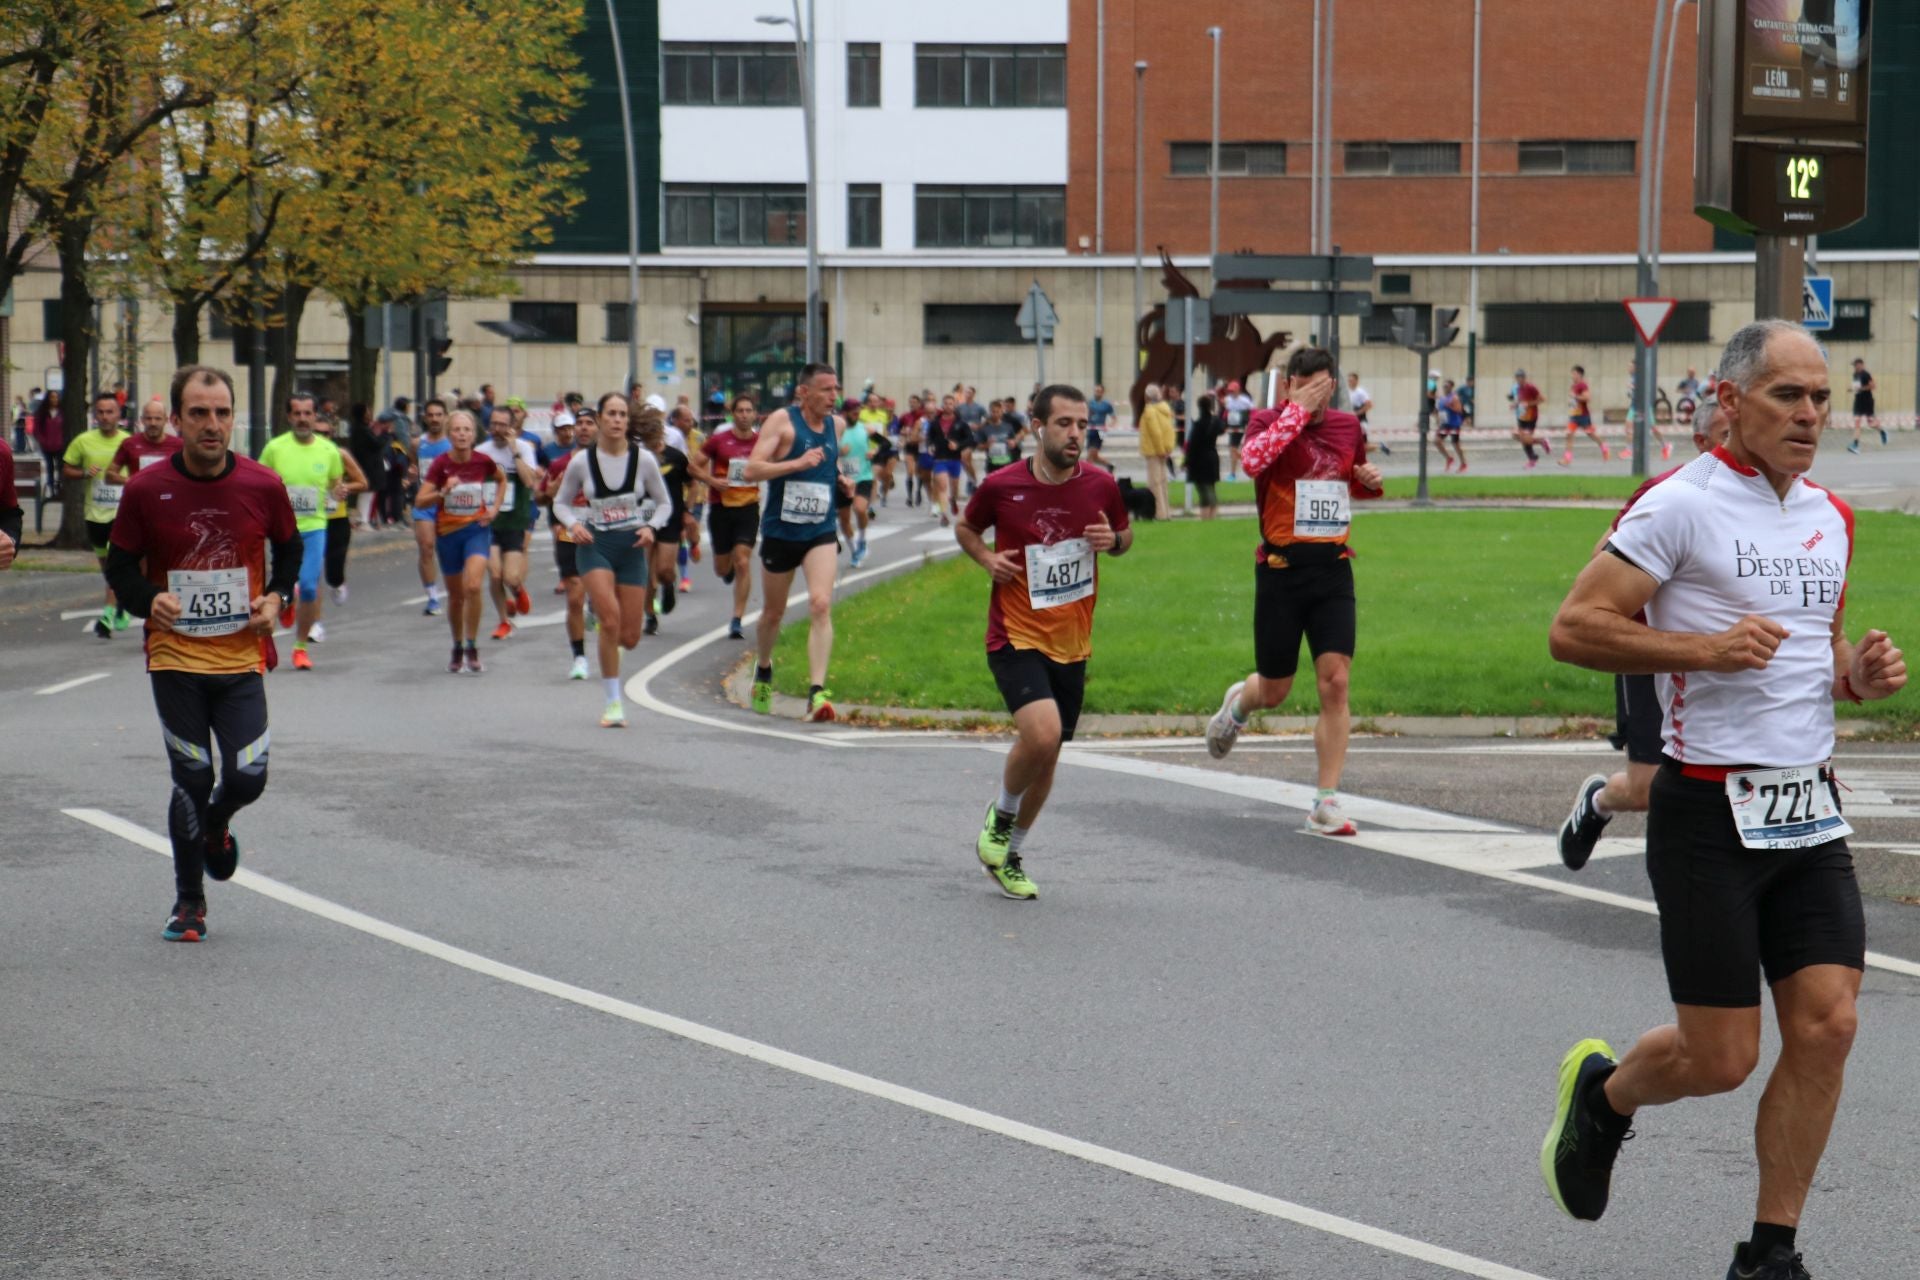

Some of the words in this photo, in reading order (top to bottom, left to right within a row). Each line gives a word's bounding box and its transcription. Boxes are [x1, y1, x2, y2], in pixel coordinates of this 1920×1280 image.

[1765, 66, 1788, 88] LEÓN
[794, 496, 819, 513] 233
[1310, 499, 1340, 521] 962
[1735, 539, 1760, 556] LA
[1801, 529, 1824, 551] land
[1045, 560, 1080, 588] 487
[1736, 557, 1843, 578] DESPENSA
[1769, 580, 1793, 596] DE
[189, 591, 231, 617] 433
[201, 623, 238, 632] HYUNDAI
[1781, 769, 1801, 780] RAFA
[1760, 779, 1816, 826] 222
